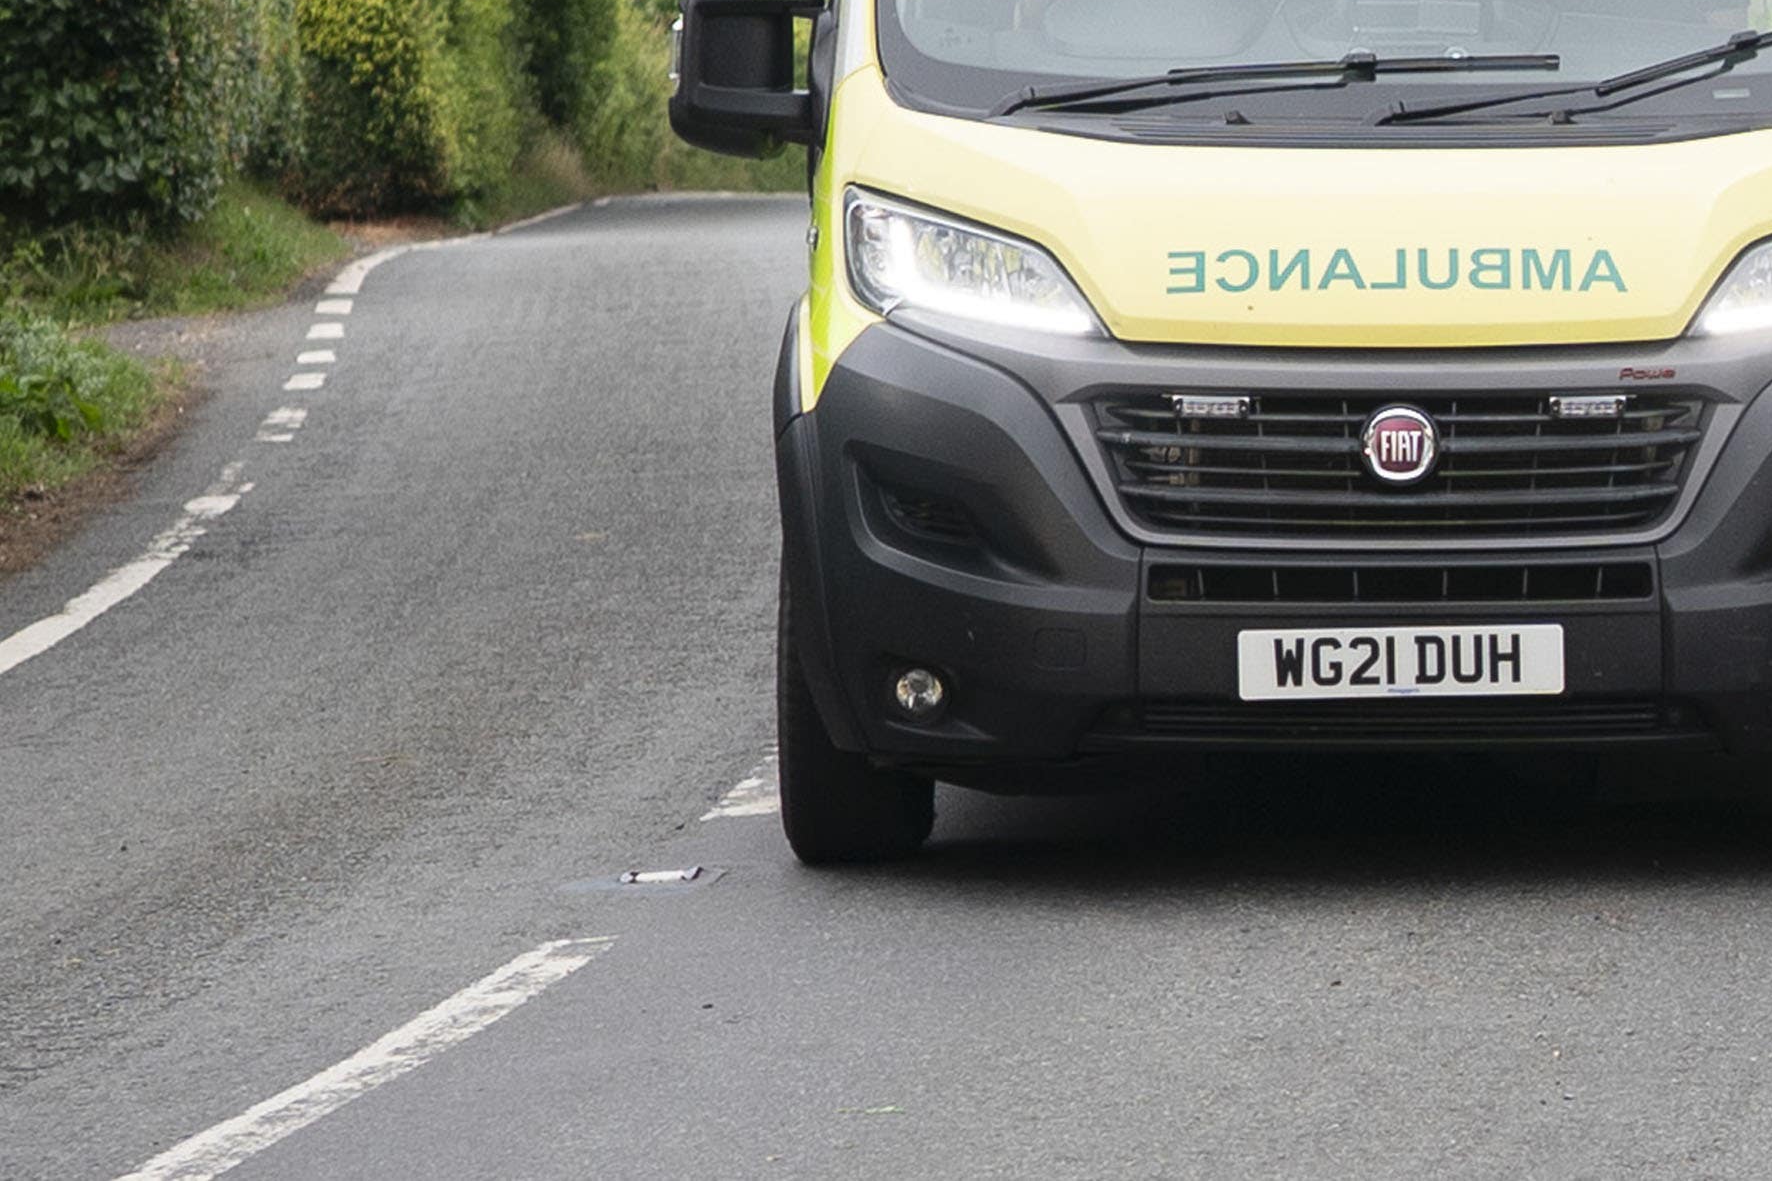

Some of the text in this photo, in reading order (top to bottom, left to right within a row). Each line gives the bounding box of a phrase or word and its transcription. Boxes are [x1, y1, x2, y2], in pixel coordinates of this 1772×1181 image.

[1381, 430, 1421, 462] FIAT
[1273, 633, 1521, 688] WG21 DUH
